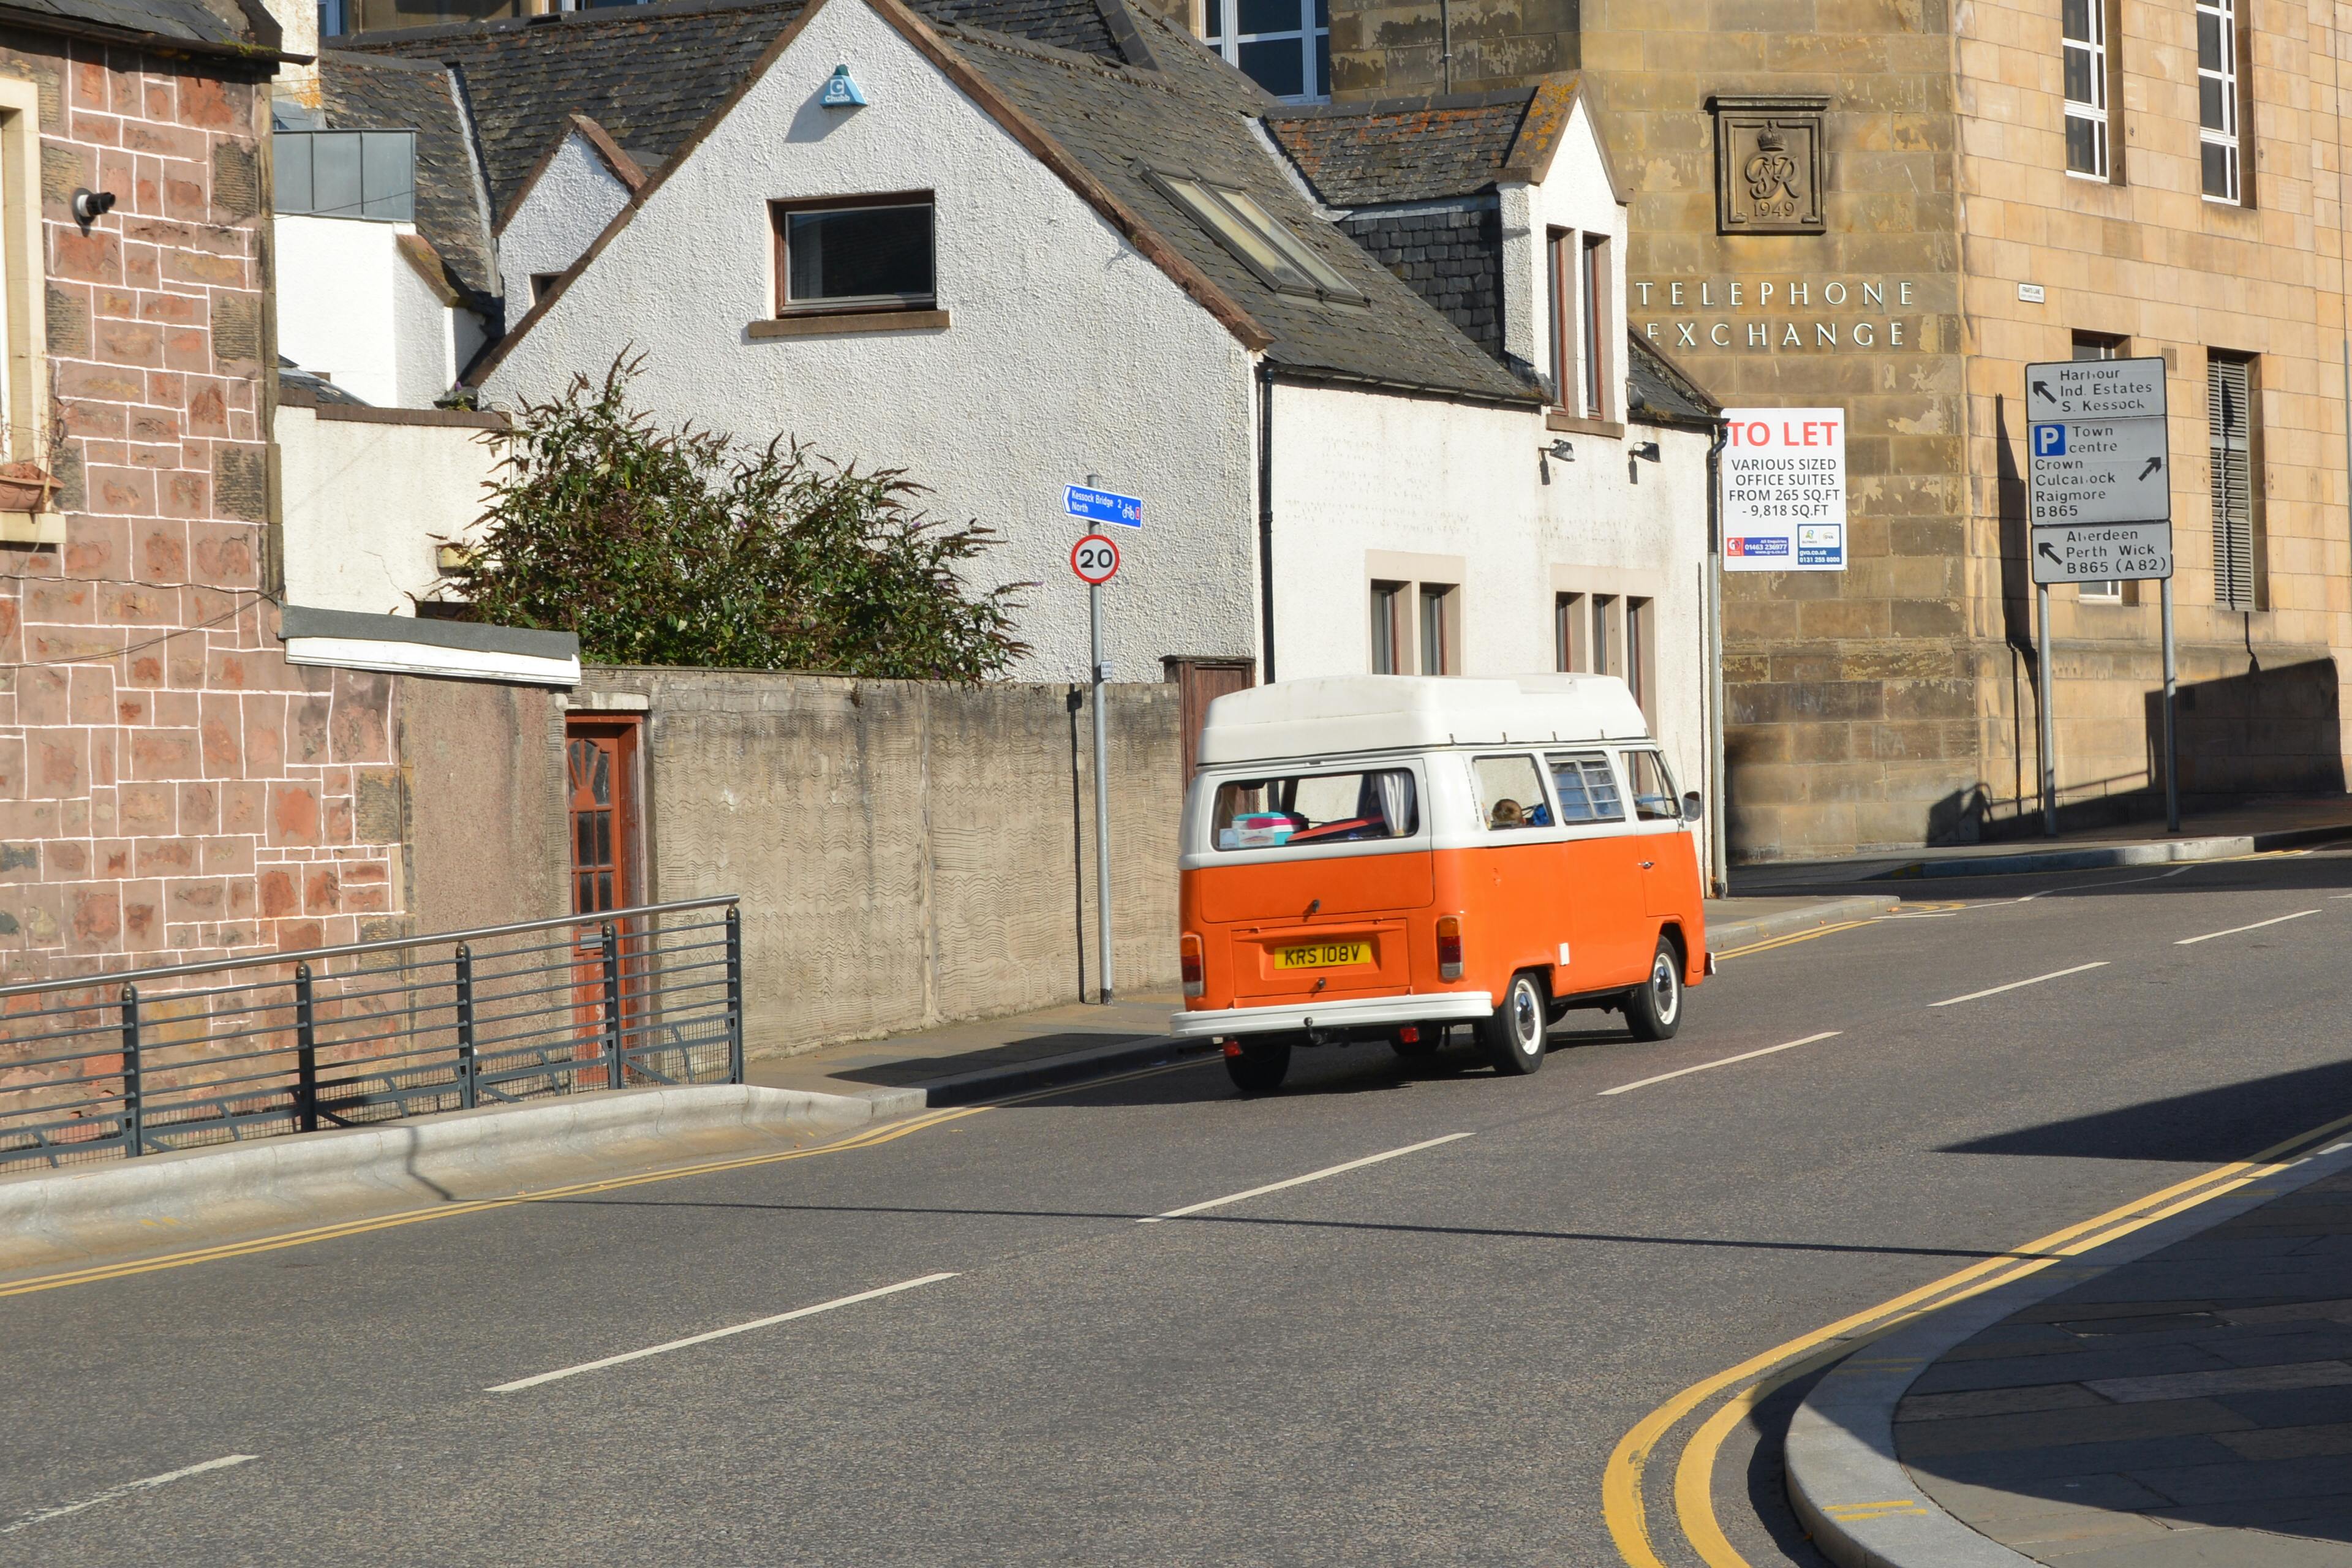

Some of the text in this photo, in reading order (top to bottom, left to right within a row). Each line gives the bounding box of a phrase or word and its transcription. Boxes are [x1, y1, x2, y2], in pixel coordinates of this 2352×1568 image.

[1754, 202, 1795, 217] 1949
[1634, 281, 1913, 306] TELEPHONE
[1646, 322, 1904, 347] EXCHANGE
[2060, 382, 2152, 397] Ind. Estates
[2062, 399, 2144, 412] S. Kessock
[1727, 421, 1839, 447] TO LET
[2040, 426, 2113, 453] P Town
[2069, 441, 2117, 453] centre
[1731, 459, 1837, 471] VARIOUS SIZED
[2035, 459, 2083, 470] Crown
[1735, 474, 1835, 486] OFFICE SUITES
[1072, 489, 1122, 509] Kessock Bridge 2
[1728, 489, 1841, 503] FROM 265 SQ.FT
[2036, 491, 2106, 503] Raigmore
[1072, 501, 1088, 513] North
[1751, 504, 1788, 519] 9,818
[1792, 504, 1830, 519] SQ.FT
[1080, 549, 1113, 568] 20
[2066, 544, 2155, 558] Perth Wick
[1285, 945, 1360, 966] KRS 108V
